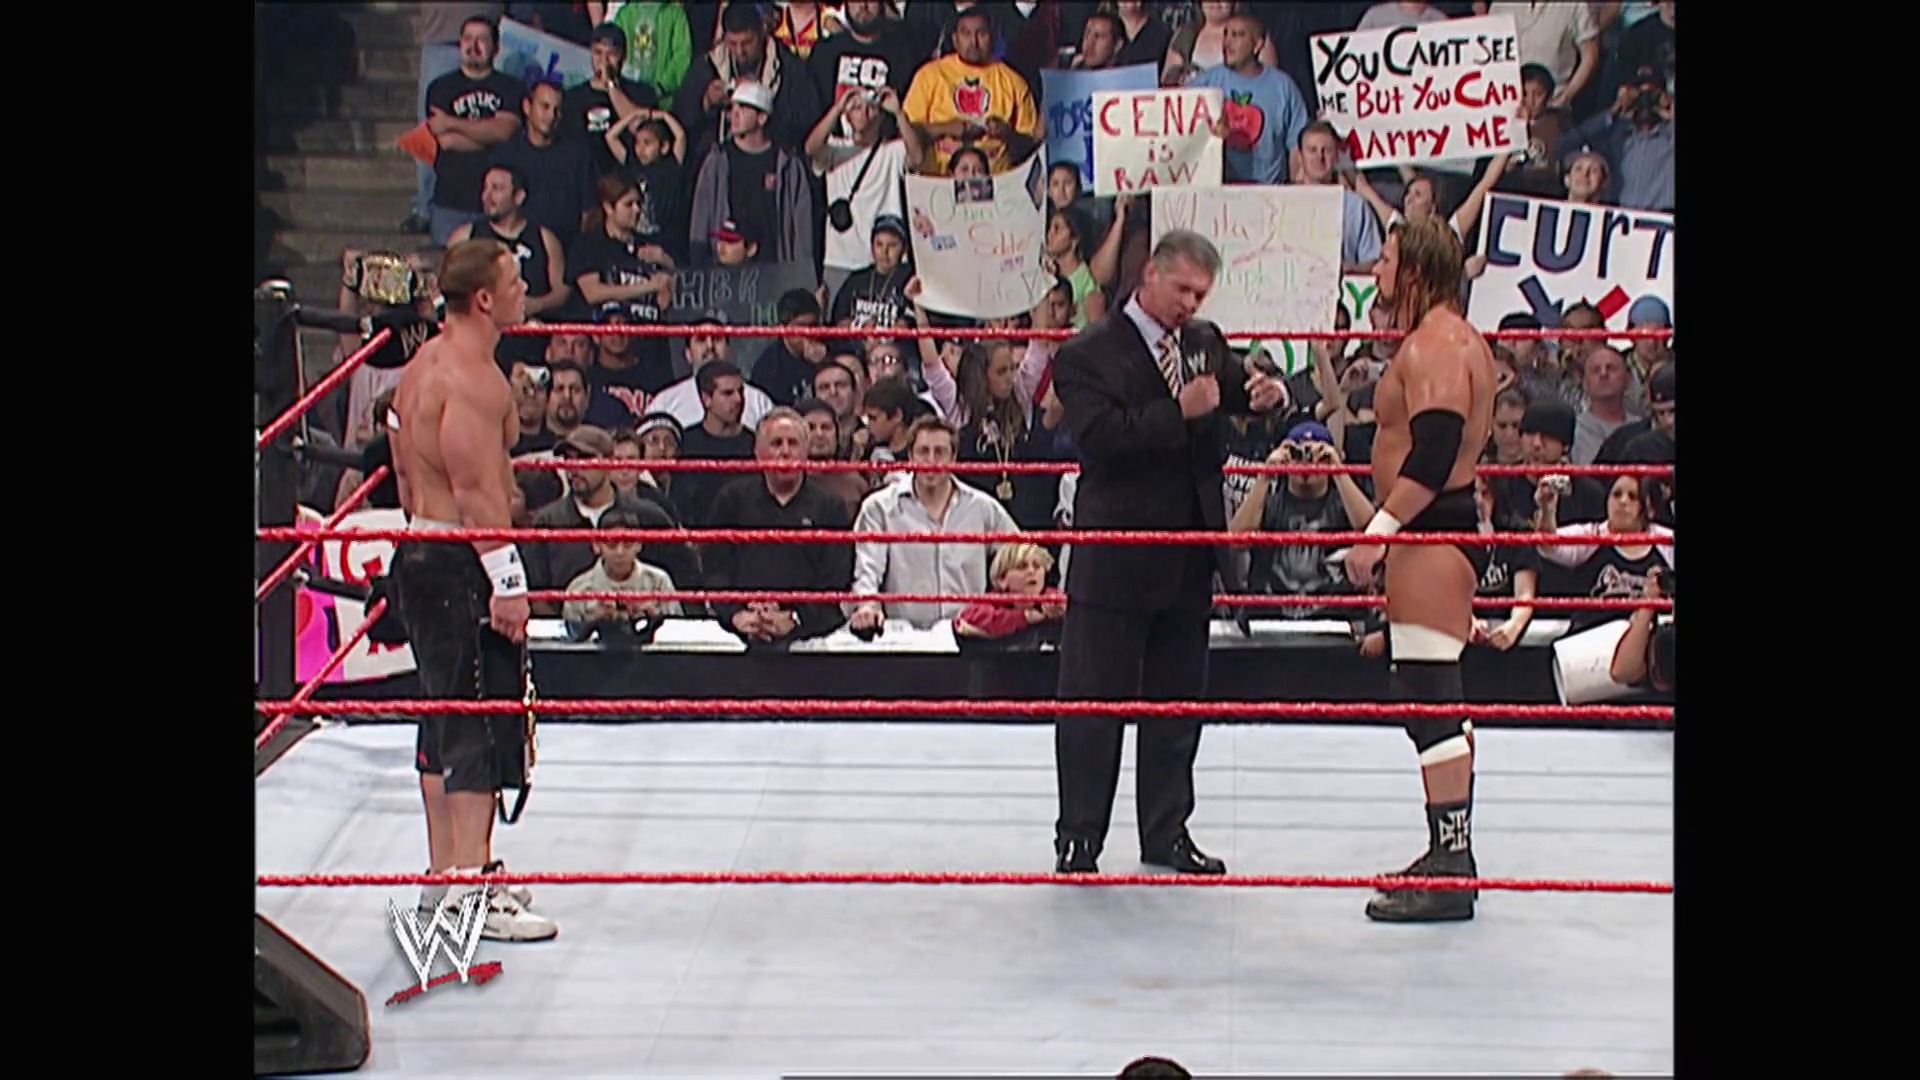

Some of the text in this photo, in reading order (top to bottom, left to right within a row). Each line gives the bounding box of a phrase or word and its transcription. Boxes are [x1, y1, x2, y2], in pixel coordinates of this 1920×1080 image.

[1473, 34, 1516, 65] SEE
[1099, 94, 1217, 138] CENA
[1320, 90, 1347, 114] ME
[1465, 115, 1511, 149] ME
[1113, 160, 1199, 192] RAW
[672, 268, 761, 310] HBK
